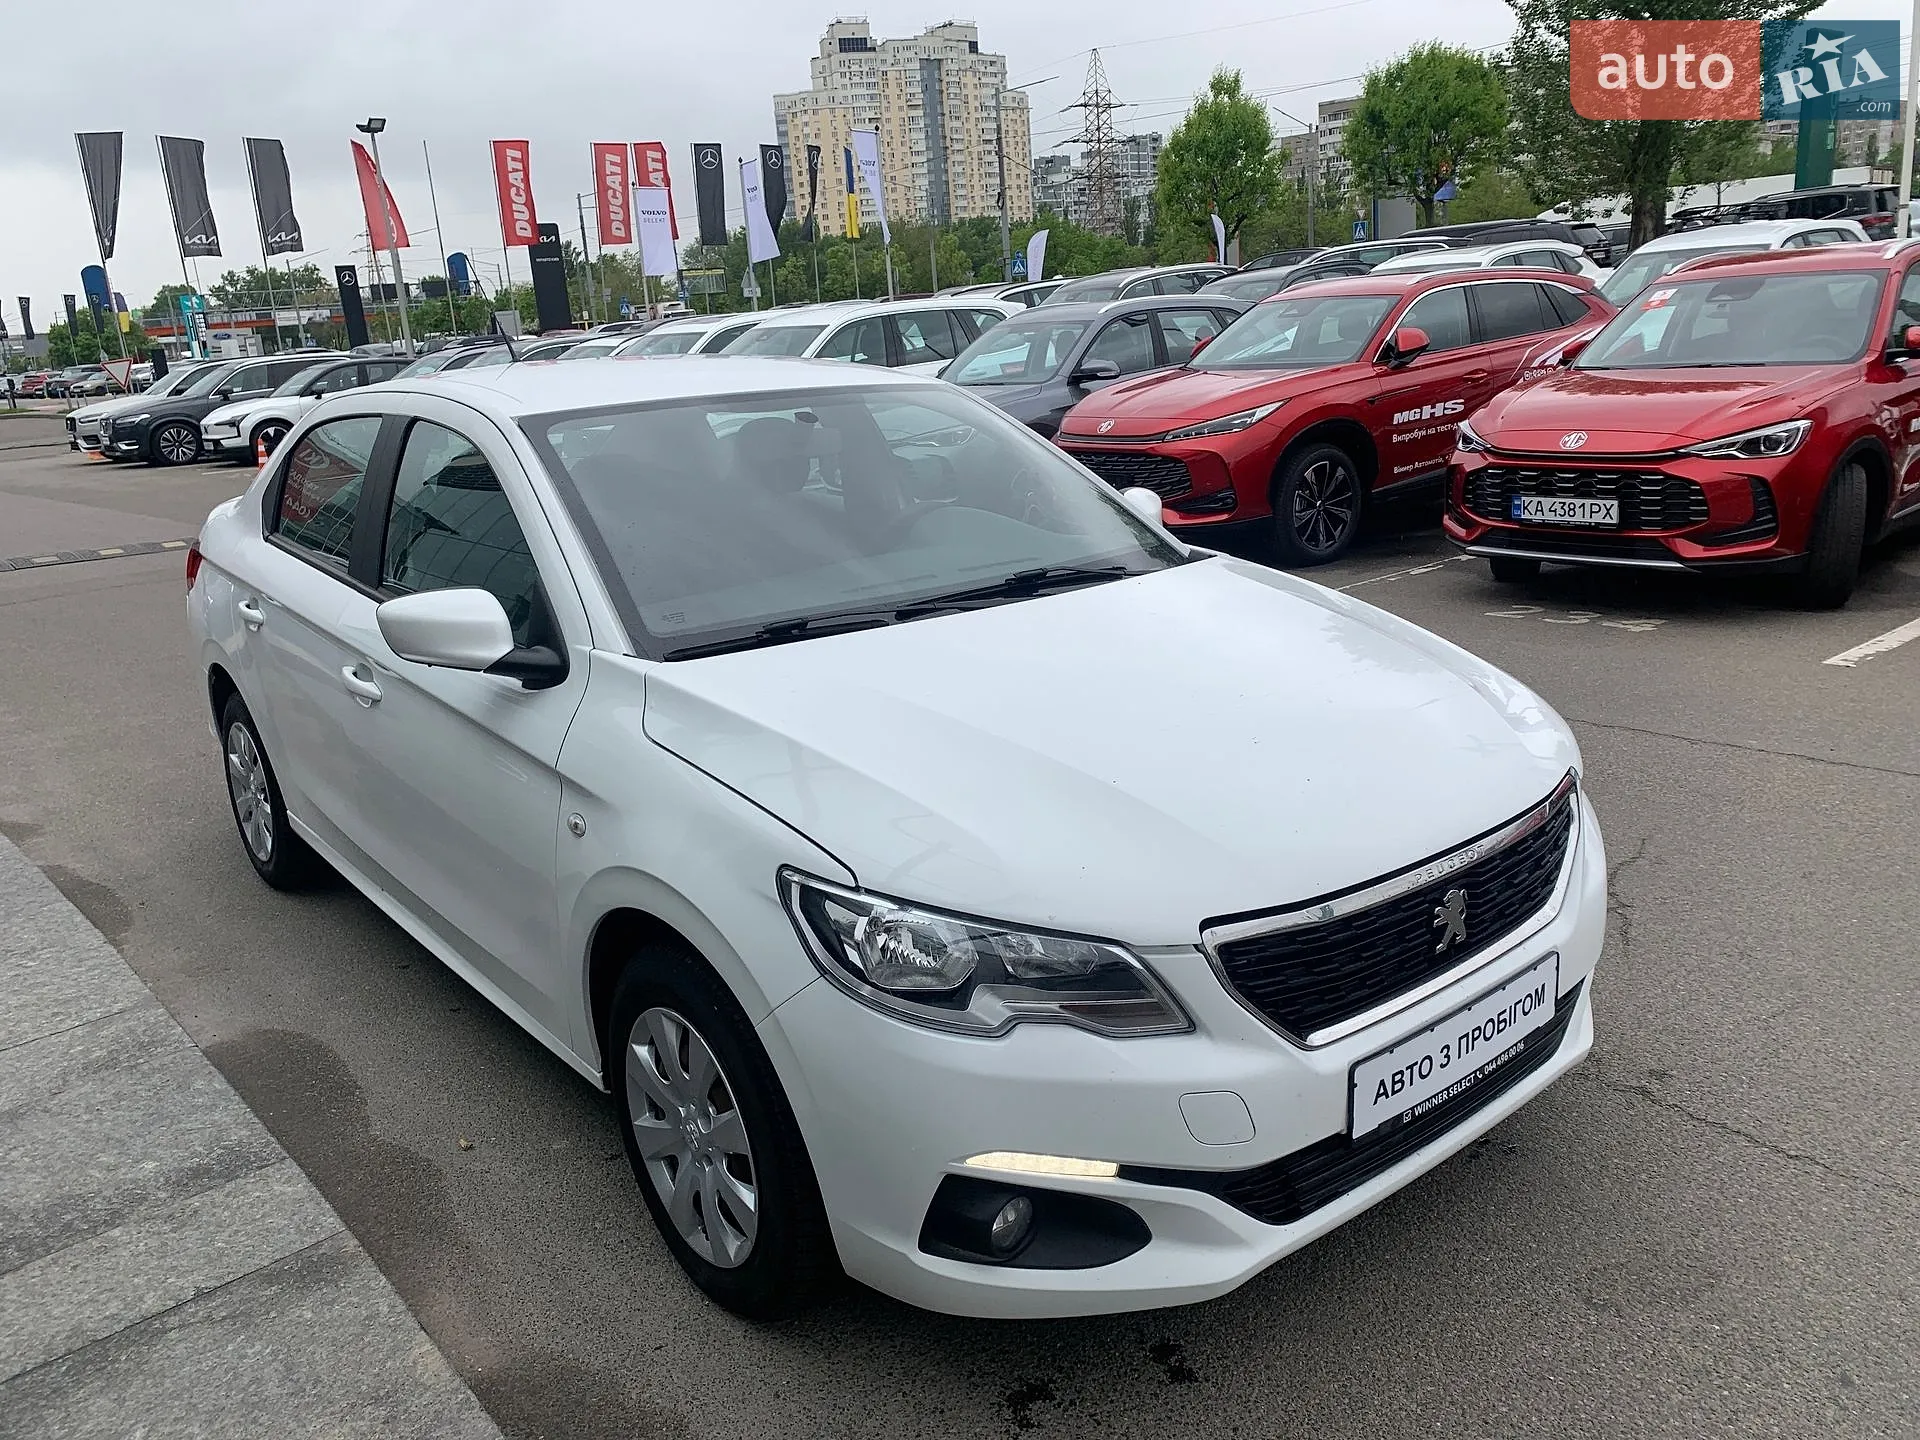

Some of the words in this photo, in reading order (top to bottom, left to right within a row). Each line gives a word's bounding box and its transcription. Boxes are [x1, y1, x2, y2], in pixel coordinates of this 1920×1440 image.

[505, 148, 532, 238] DUCATI
[604, 153, 626, 238] DUCATI
[1392, 427, 1427, 443] Випробуй
[1427, 428, 1436, 436] на
[1414, 844, 1486, 884] PEUGEOT
[1373, 1054, 1434, 1106] АВТО
[1457, 983, 1546, 1060] ПРОБІГОМ
[1414, 1090, 1449, 1117] WINNER
[1449, 1073, 1476, 1098] SELECT
[1484, 1061, 1497, 1075] 044
